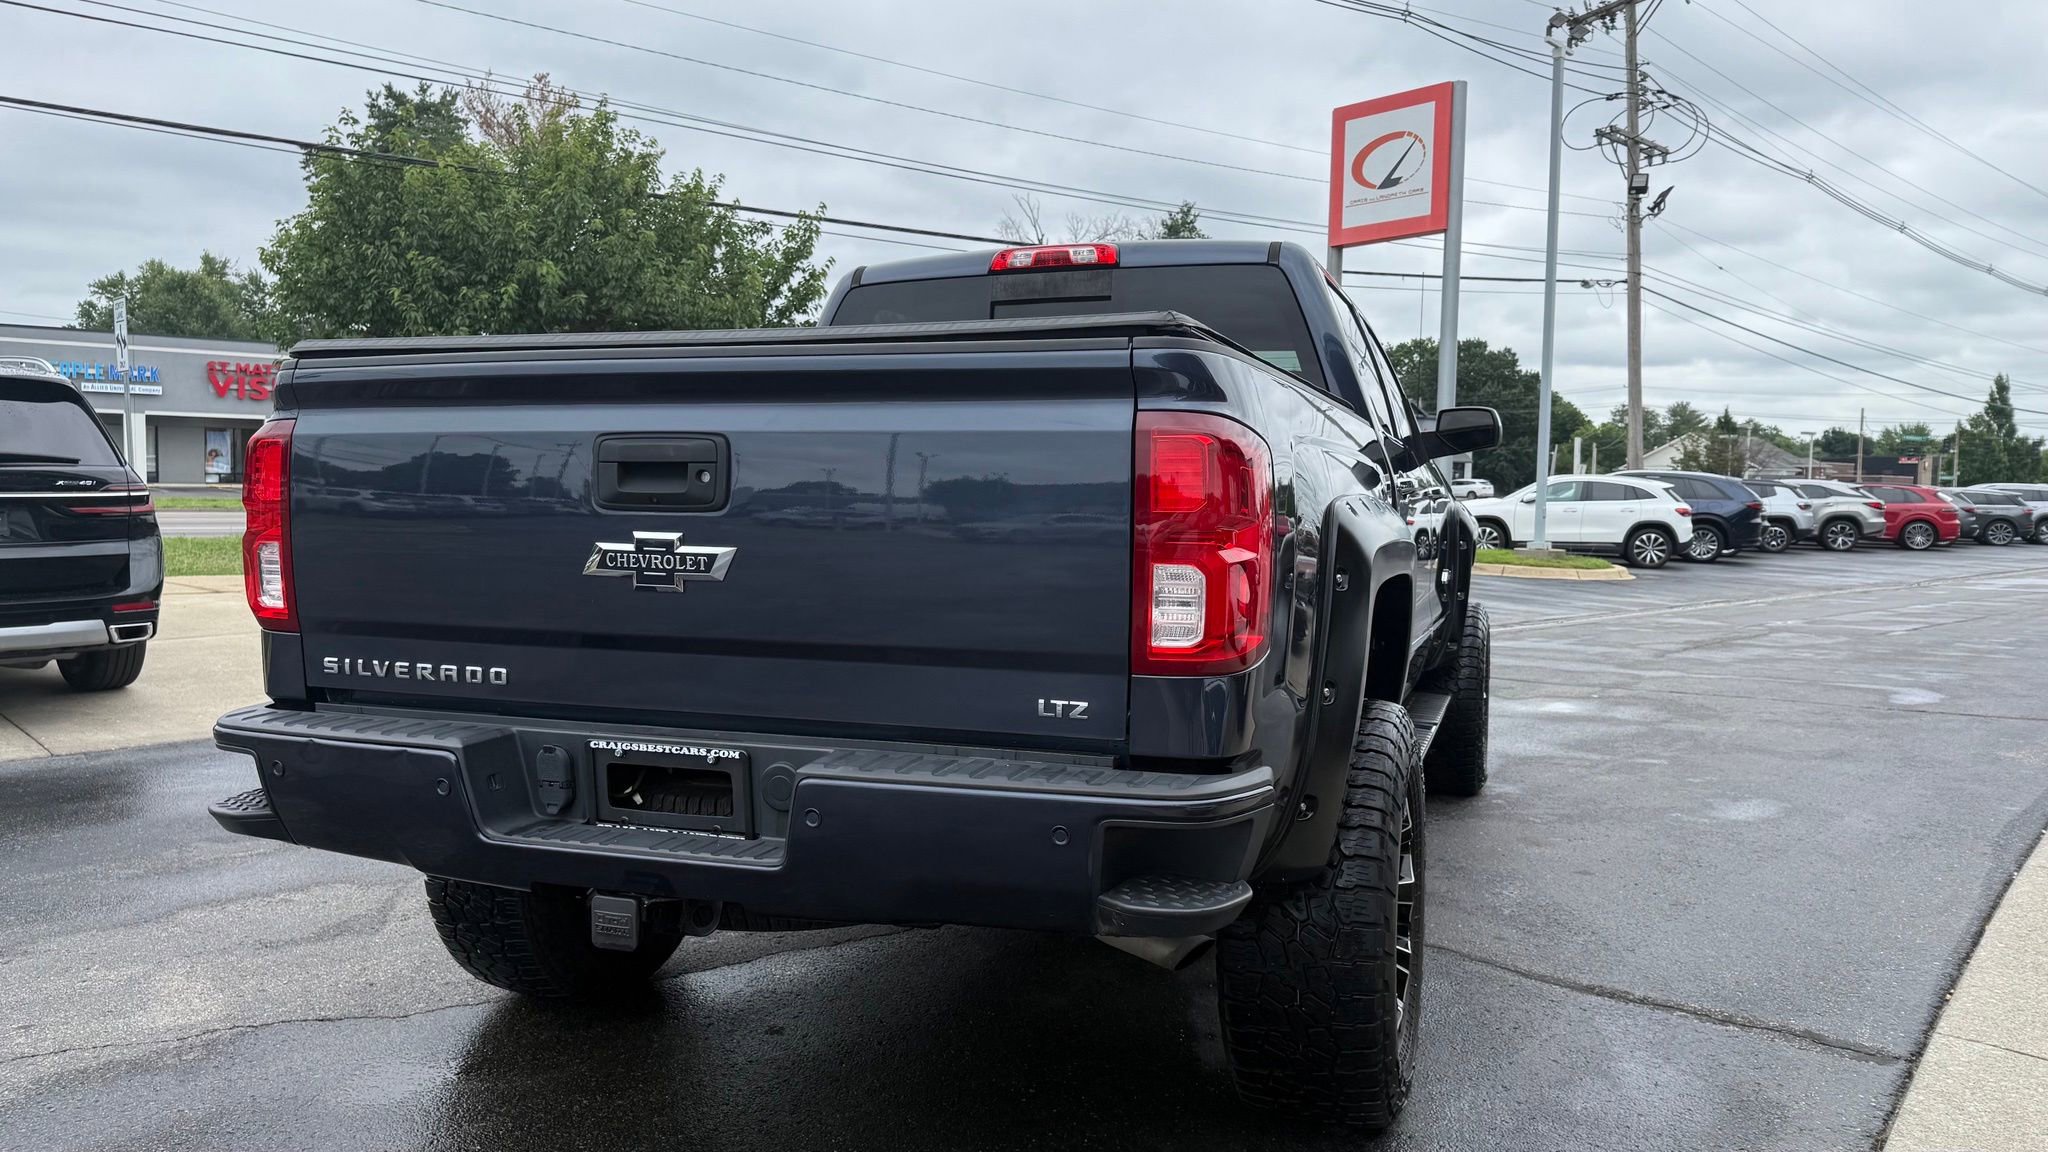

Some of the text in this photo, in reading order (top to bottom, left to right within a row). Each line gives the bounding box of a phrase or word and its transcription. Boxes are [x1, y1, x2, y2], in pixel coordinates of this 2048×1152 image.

[605, 552, 708, 571] CHEVROLET
[323, 656, 507, 686] SILVERADO
[1038, 698, 1089, 720] LTZ
[589, 740, 741, 759] CRAIGSBESTCARS.COM
